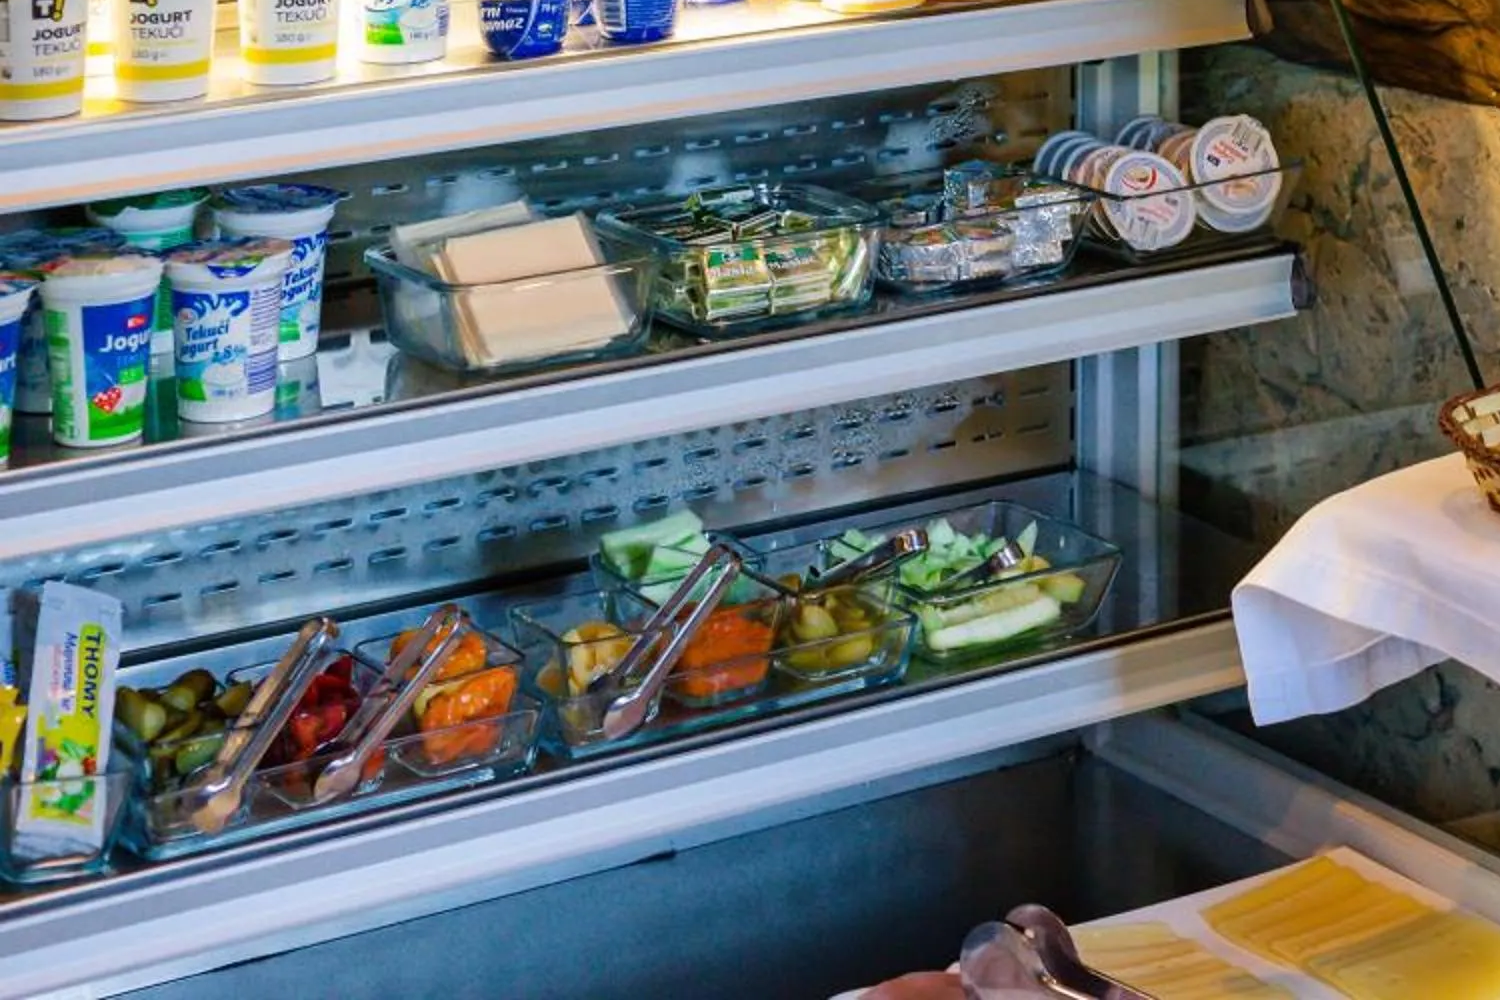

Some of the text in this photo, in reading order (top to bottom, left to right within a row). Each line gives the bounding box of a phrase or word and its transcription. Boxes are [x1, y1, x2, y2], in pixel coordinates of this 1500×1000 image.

[130, 9, 192, 24] JOGURT
[98, 328, 151, 353] Jogu
[185, 317, 229, 341] Tekući
[82, 632, 102, 718] THOMY
